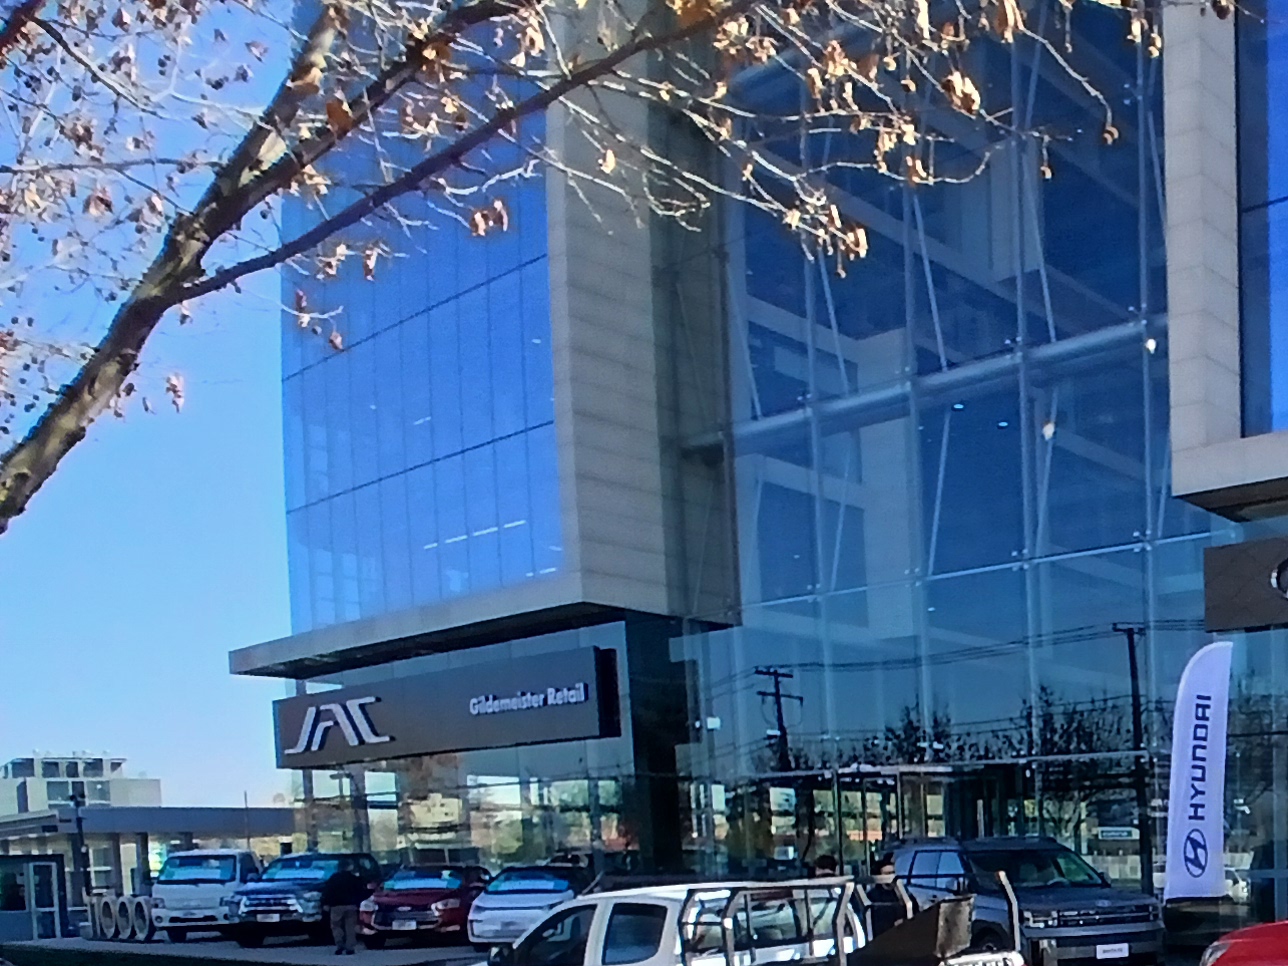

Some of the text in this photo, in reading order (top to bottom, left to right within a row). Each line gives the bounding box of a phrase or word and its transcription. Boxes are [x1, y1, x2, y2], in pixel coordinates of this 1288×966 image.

[470, 682, 585, 715] Gildemeister Retail
[1189, 695, 1212, 821] HYUNDAI
